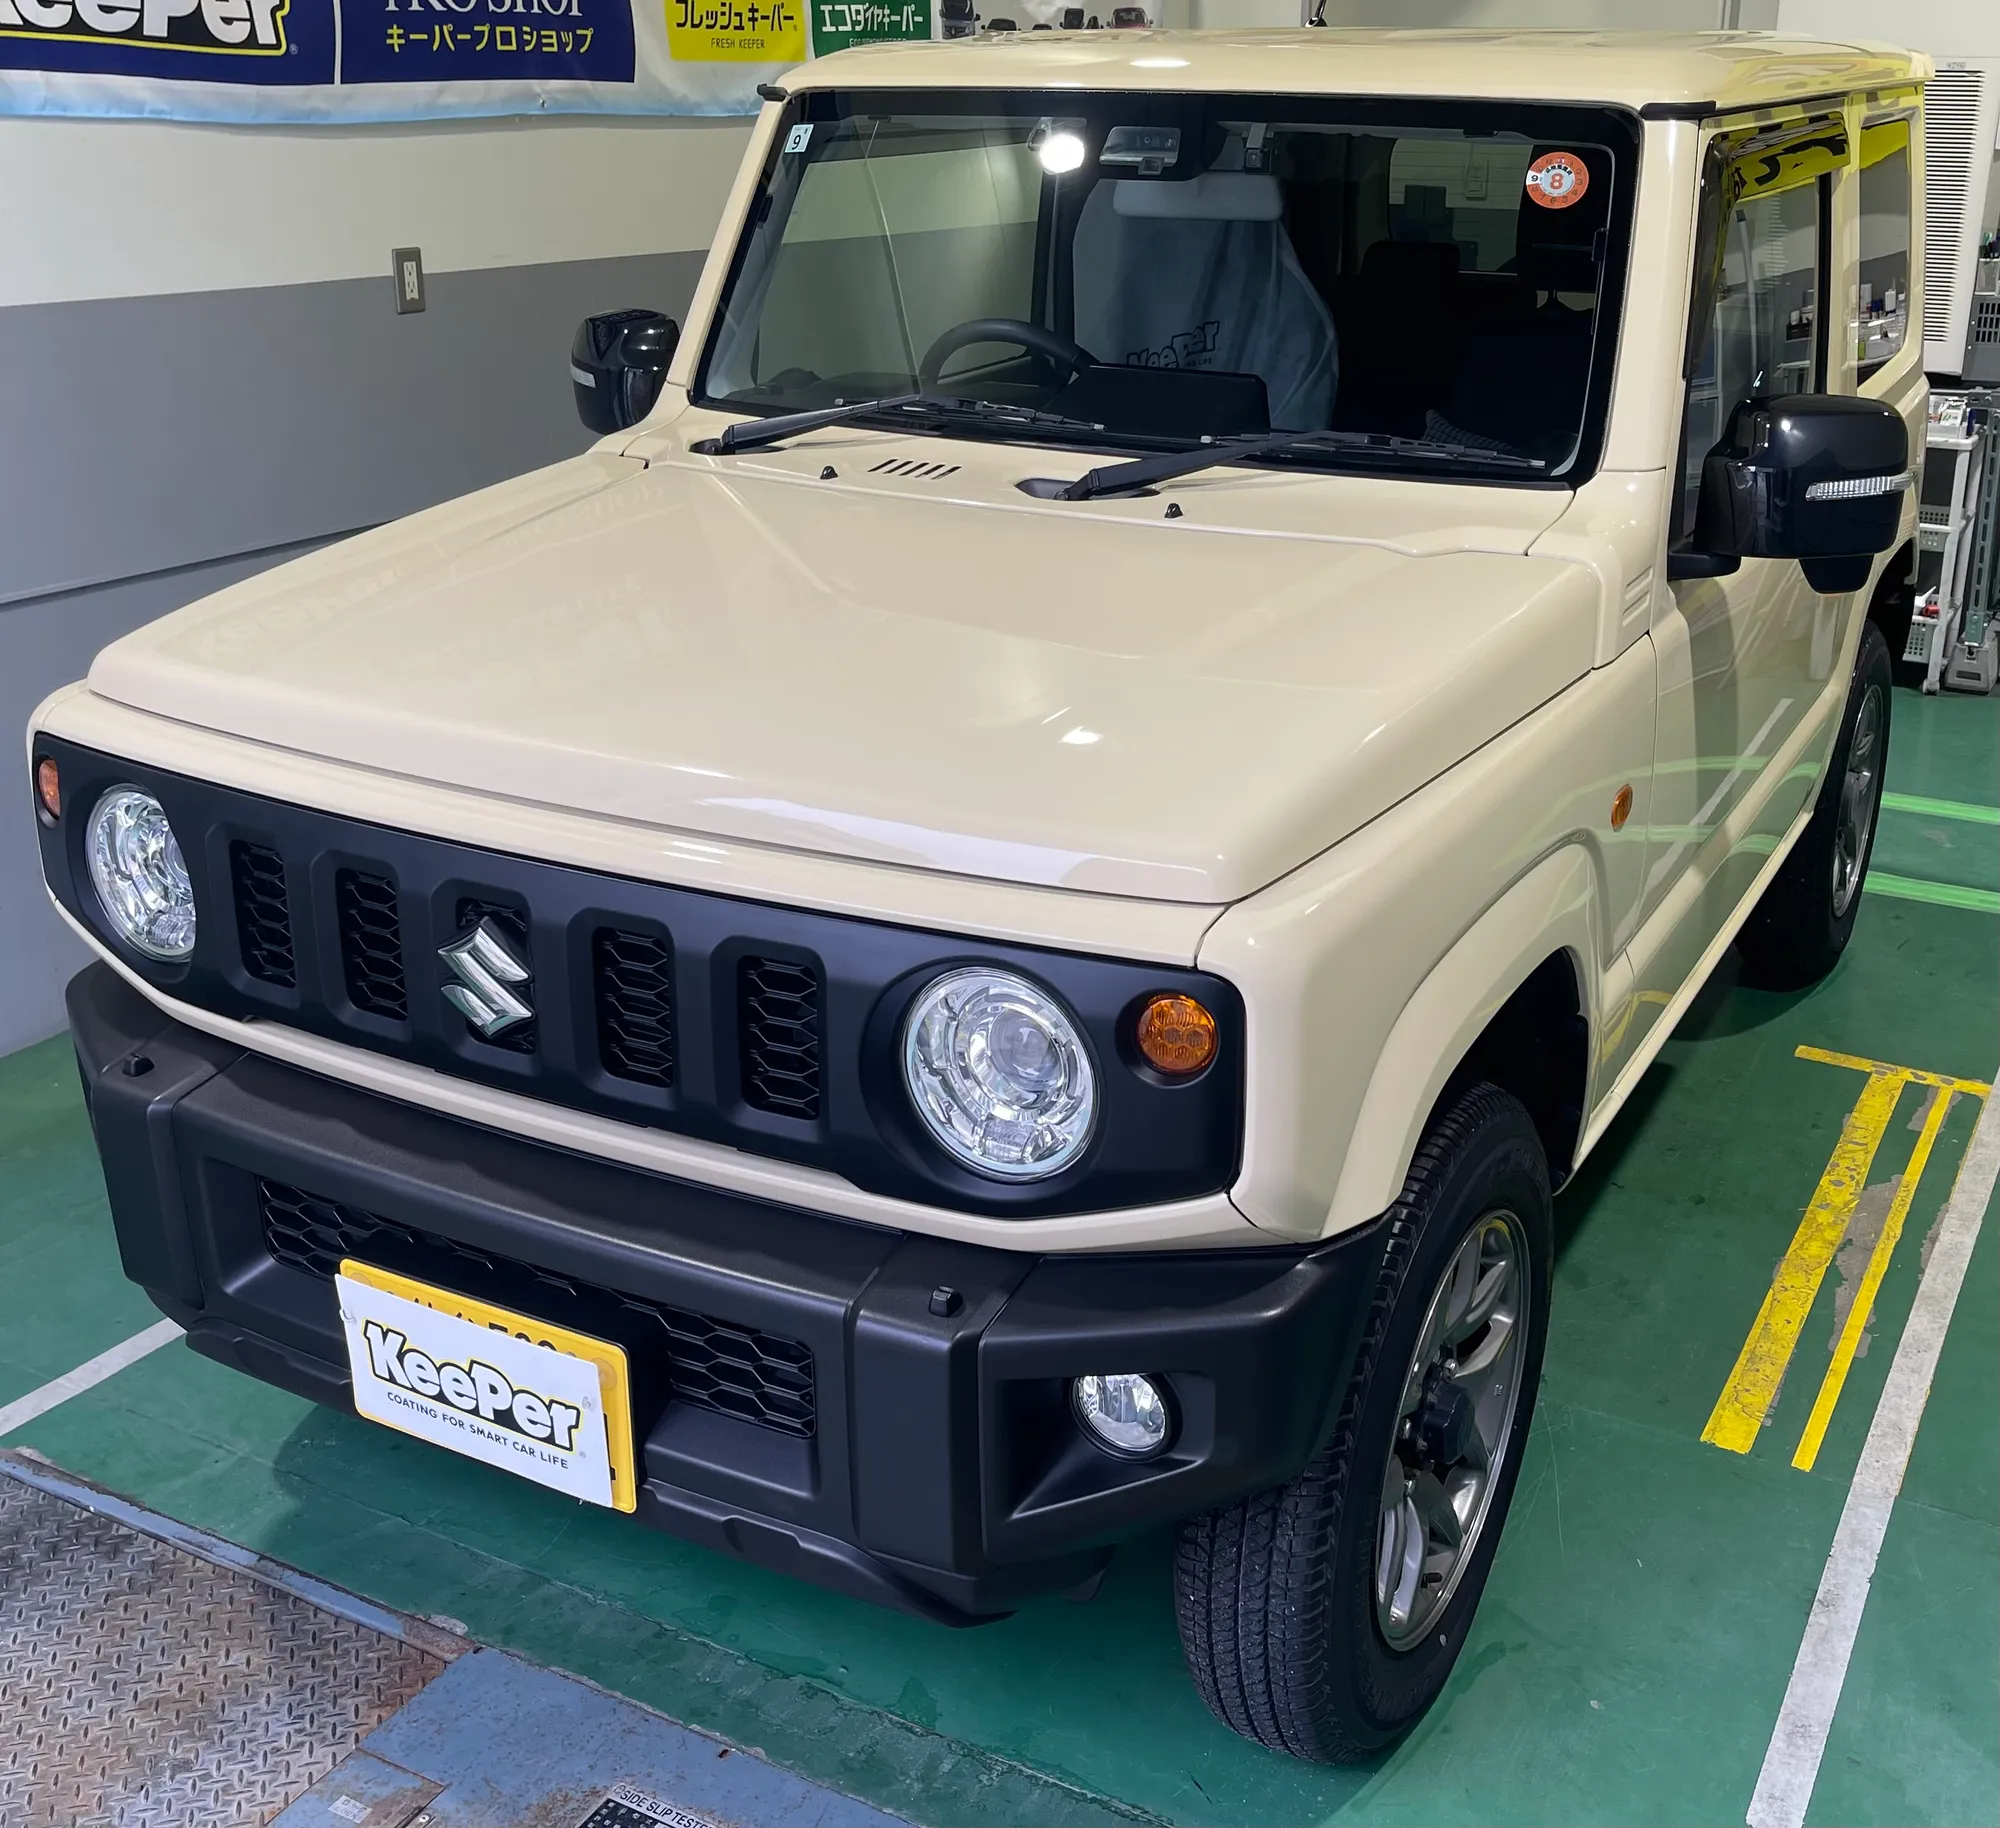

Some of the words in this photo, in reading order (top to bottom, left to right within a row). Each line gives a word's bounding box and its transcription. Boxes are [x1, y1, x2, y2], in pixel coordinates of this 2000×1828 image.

[675, 0, 794, 31] フレッシュキーパー
[820, 3, 923, 31] エコダイヤキーパー
[386, 24, 594, 53] キーパープロショップ
[711, 38, 735, 48] FRESH
[739, 38, 765, 49] KEEPER
[792, 134, 801, 150] 9
[1531, 174, 1539, 182] 9
[1549, 172, 1564, 190] 8
[364, 1320, 581, 1452] KeePer
[387, 1392, 438, 1418] COATING
[442, 1413, 466, 1430] FOR
[470, 1424, 508, 1446] SMART
[512, 1441, 536, 1458] CAR
[540, 1452, 568, 1469] LIFE
[620, 1790, 649, 1808] SIDE
[646, 1801, 673, 1818] SLIP
